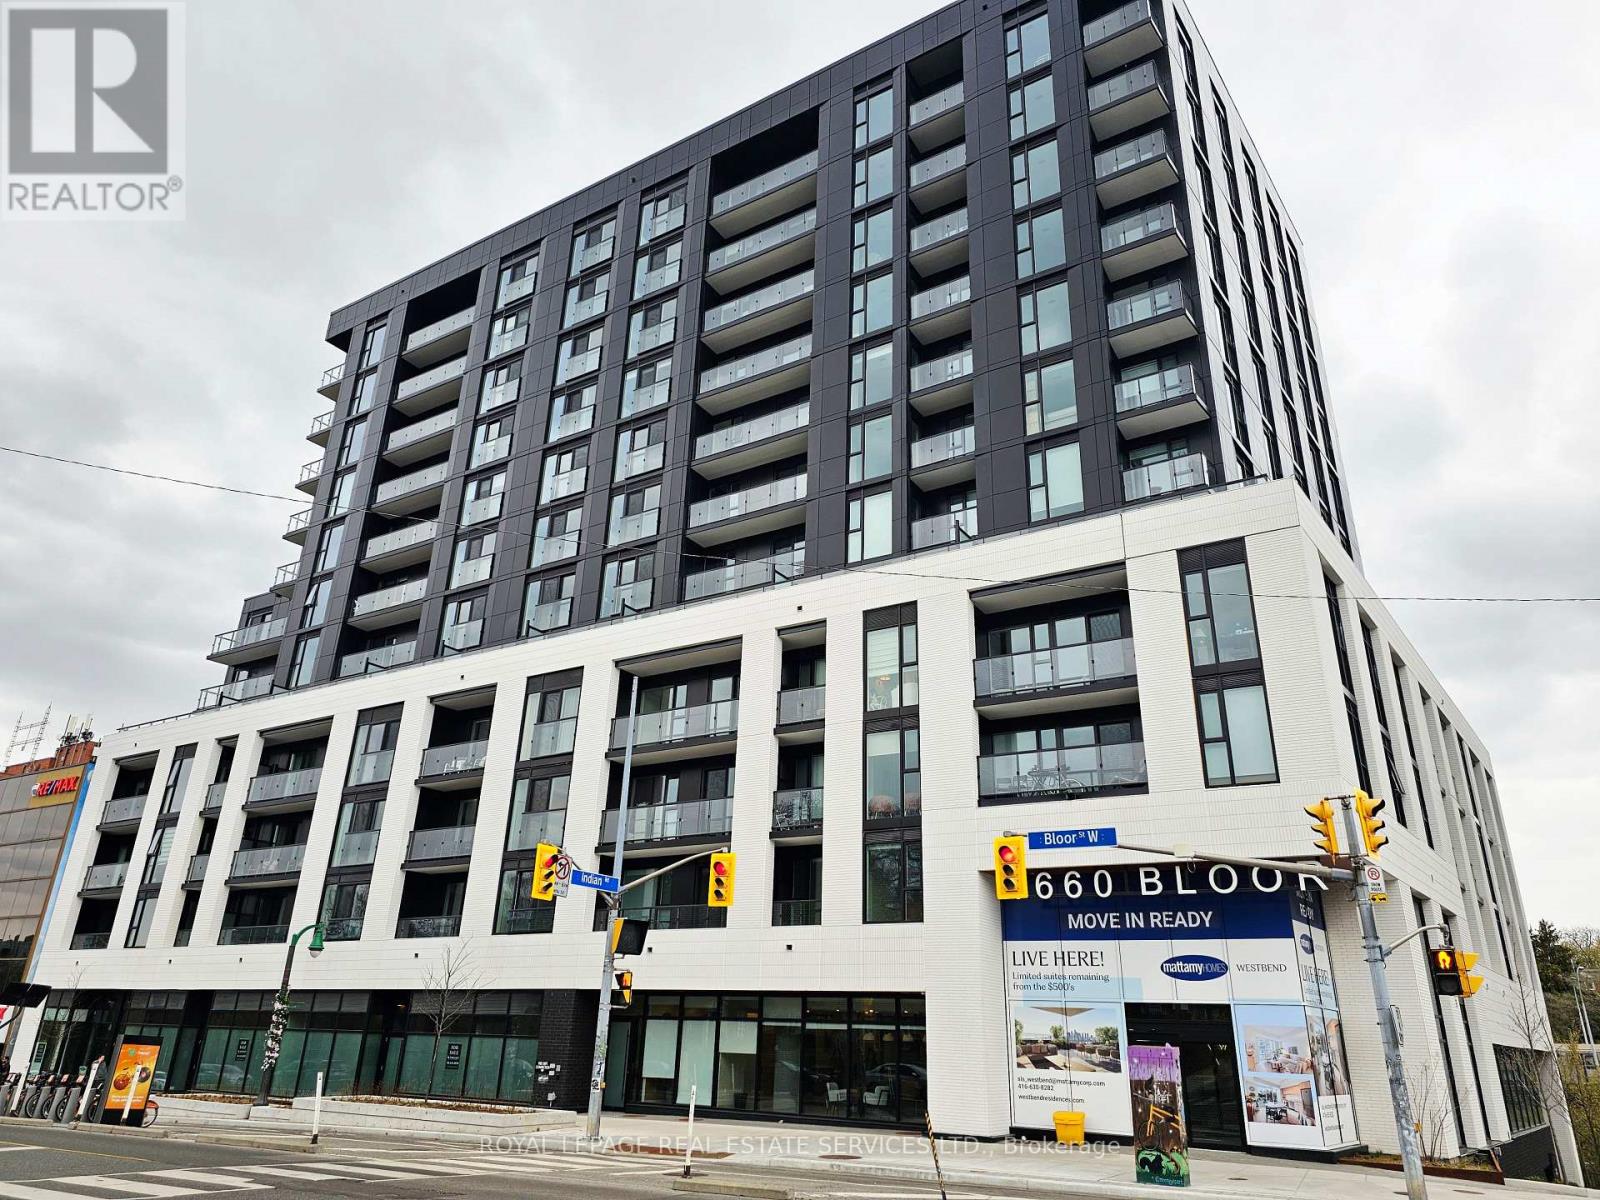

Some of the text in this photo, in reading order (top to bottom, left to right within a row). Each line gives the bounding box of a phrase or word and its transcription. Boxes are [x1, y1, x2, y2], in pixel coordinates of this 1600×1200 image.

[37, 776, 79, 797] RE/MAX
[1044, 832, 1078, 845] Bloor
[1087, 830, 1098, 843] W
[581, 872, 603, 886] Indian
[1139, 861, 1329, 896] BLOOR
[1068, 911, 1213, 929] MOVE IN READY
[1012, 951, 1105, 967] LIVE HERE!
[1236, 963, 1287, 973] WESTBEND
[1012, 971, 1110, 983] Limited suites remaining
[1013, 982, 1075, 992] from the $500's
